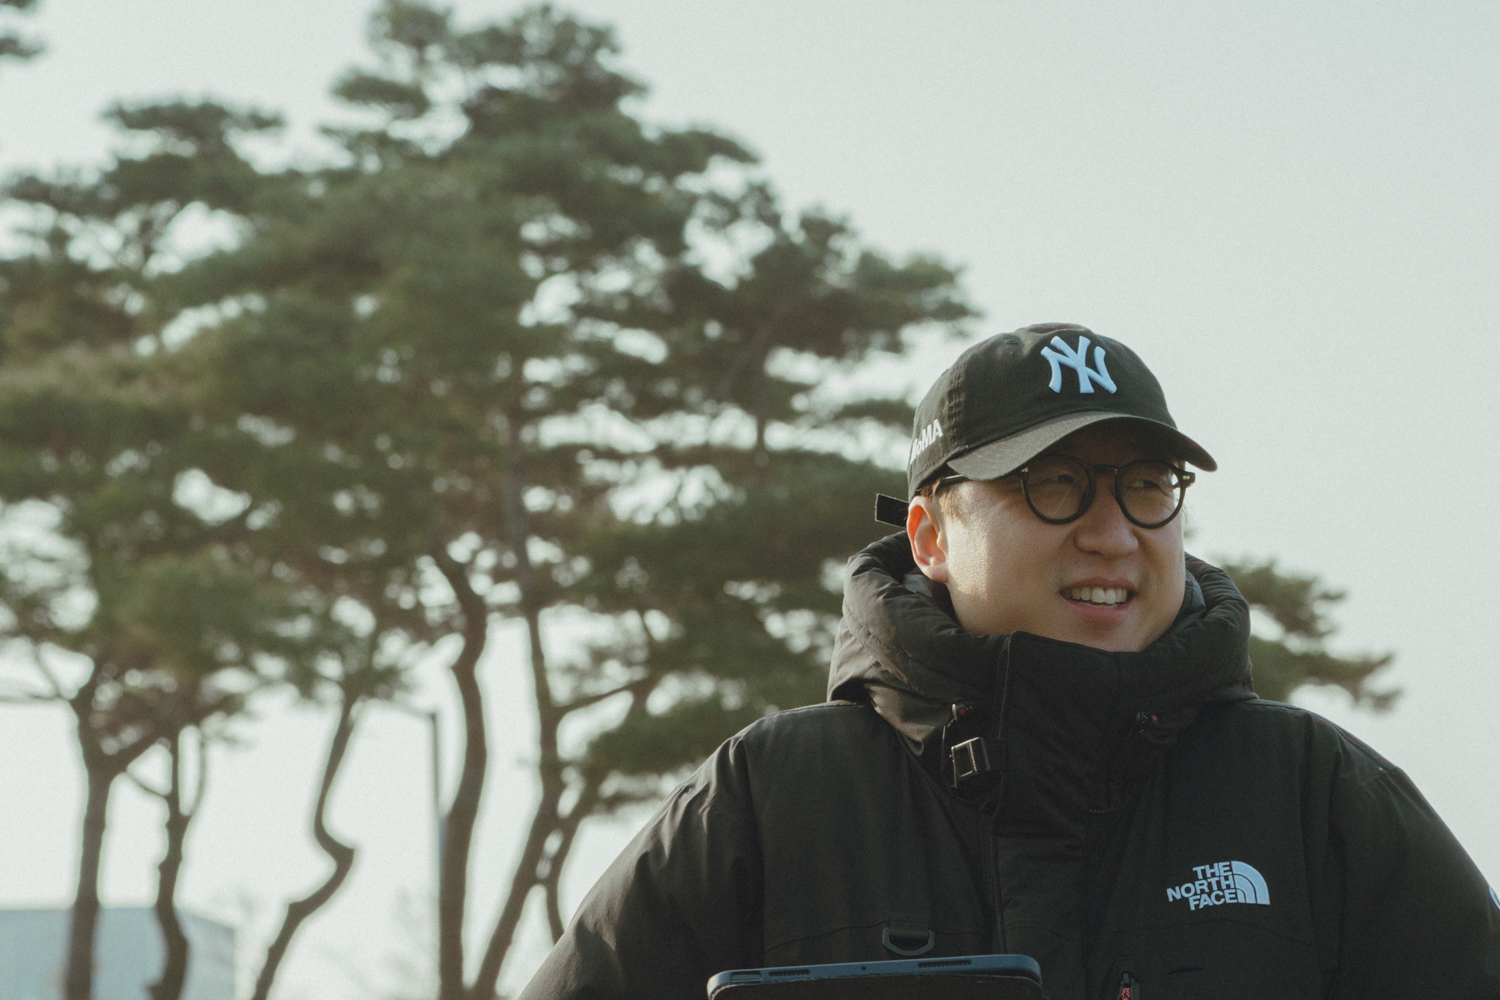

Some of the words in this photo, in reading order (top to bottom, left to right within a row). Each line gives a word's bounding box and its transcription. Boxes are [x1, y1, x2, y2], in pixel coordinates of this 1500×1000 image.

[1040, 335, 1118, 394] NY
[1192, 861, 1232, 880] THE
[1166, 874, 1235, 902] NORTH
[1188, 888, 1238, 911] FACE
